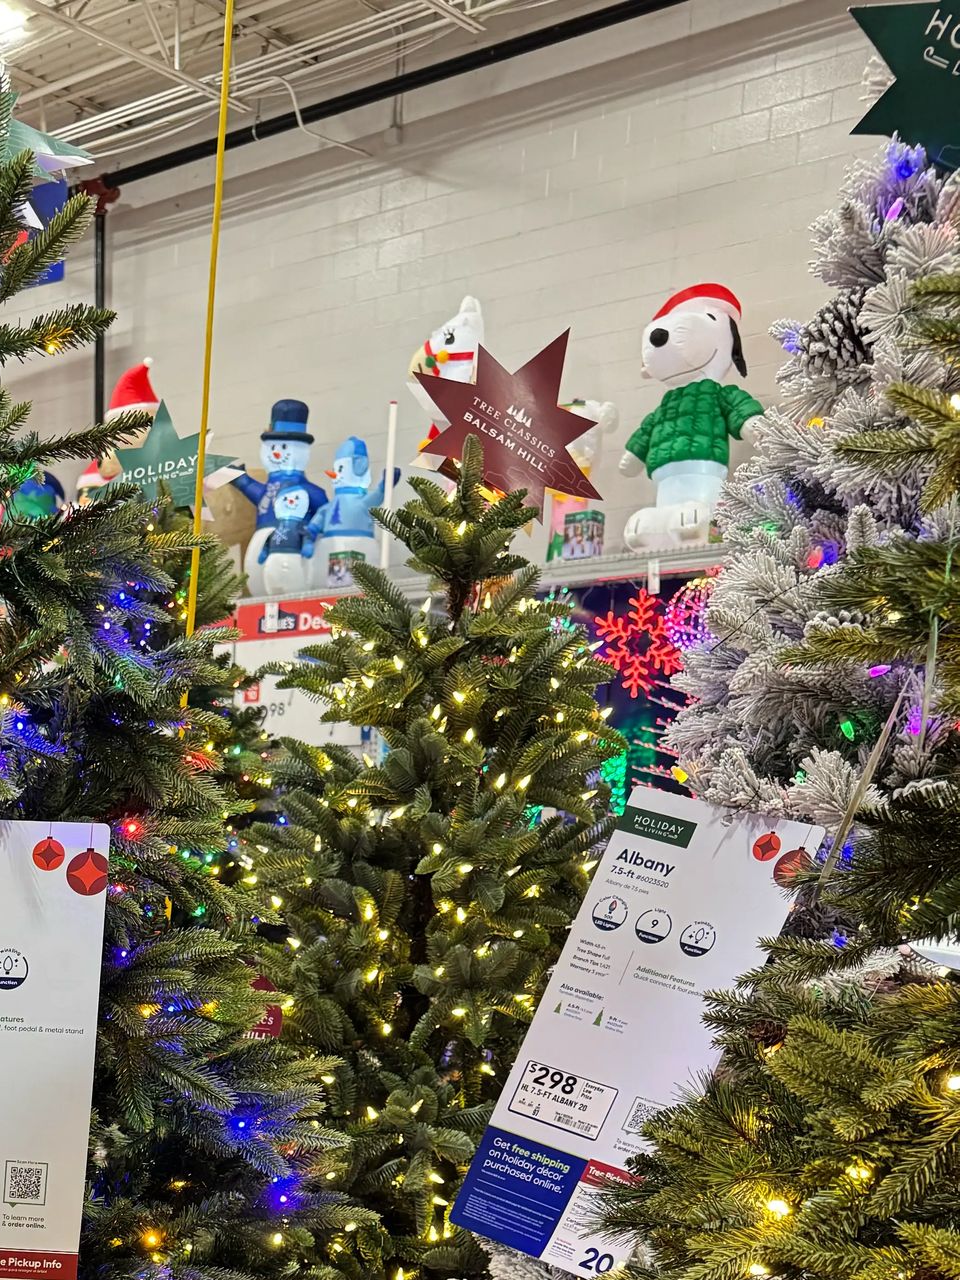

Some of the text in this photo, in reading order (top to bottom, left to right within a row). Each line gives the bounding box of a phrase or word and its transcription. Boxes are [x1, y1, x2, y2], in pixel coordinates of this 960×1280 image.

[463, 411, 515, 451] BALSAM
[472, 396, 556, 459] TREE CLASSICS
[122, 454, 198, 483] HOLIDAY
[634, 814, 684, 835] HOLIDAY
[616, 848, 676, 877] Albany
[610, 865, 670, 889] 7.5-ft #6023520
[650, 919, 659, 929] 9
[633, 972, 649, 982] Quick
[649, 978, 672, 989] connect
[635, 965, 696, 988] Additional Features
[560, 983, 605, 1001] Also available:
[4, 1024, 18, 1032] foot
[18, 1025, 38, 1033] pedal
[65, 1027, 84, 1035] stand
[529, 1063, 578, 1095] $298
[585, 1082, 605, 1094] Everyday
[520, 1083, 529, 1093] HL
[530, 1086, 552, 1100] 7.5-FT
[551, 1094, 579, 1109] ALBANY
[578, 1103, 588, 1112] 20
[580, 1092, 593, 1101] Price
[582, 1087, 592, 1095] Low
[488, 1149, 564, 1181] on holiday décor
[493, 1137, 571, 1174] Get free shipping
[483, 1159, 534, 1182] purchased
[588, 1166, 605, 1178] Tree
[11, 1214, 27, 1222] learn
[8, 1257, 41, 1269] Pickup
[43, 1259, 62, 1269] Info
[578, 1247, 615, 1275] 20
